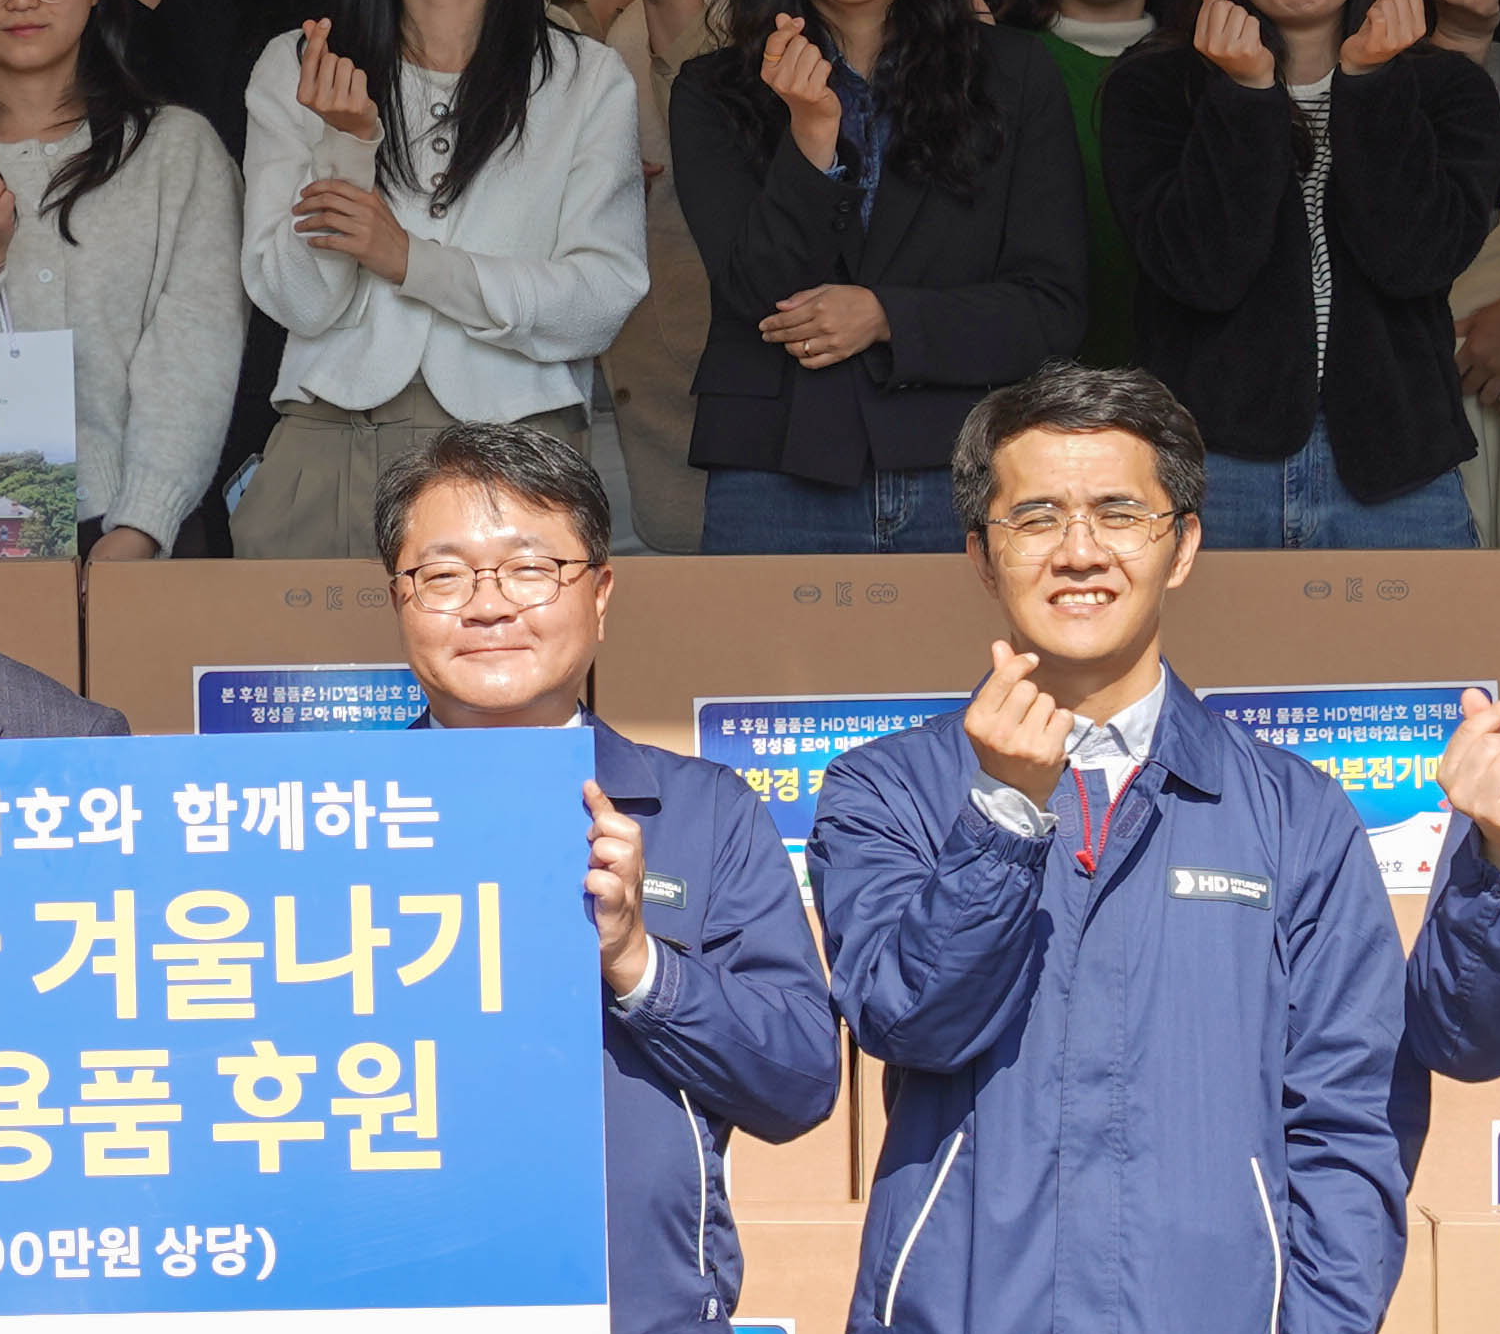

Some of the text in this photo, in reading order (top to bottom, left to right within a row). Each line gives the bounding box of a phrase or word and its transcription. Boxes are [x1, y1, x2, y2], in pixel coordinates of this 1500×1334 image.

[720, 713, 904, 735] 본 후원 물품은 HD현대삼호
[1242, 708, 1272, 726] 후원
[1276, 707, 1320, 725] 물품은
[1324, 704, 1408, 723] HD현대삼호
[752, 736, 831, 754] 정성을 모아
[1303, 727, 1334, 744] 모아
[1337, 724, 1443, 743] 마련하였습니다
[735, 767, 800, 803] 환경
[174, 779, 441, 855] 함께하는
[1198, 875, 1229, 893] HD
[31, 880, 504, 1021] 겨울나기
[211, 1038, 442, 1174] 후원
[154, 1222, 277, 1281] 상당)
